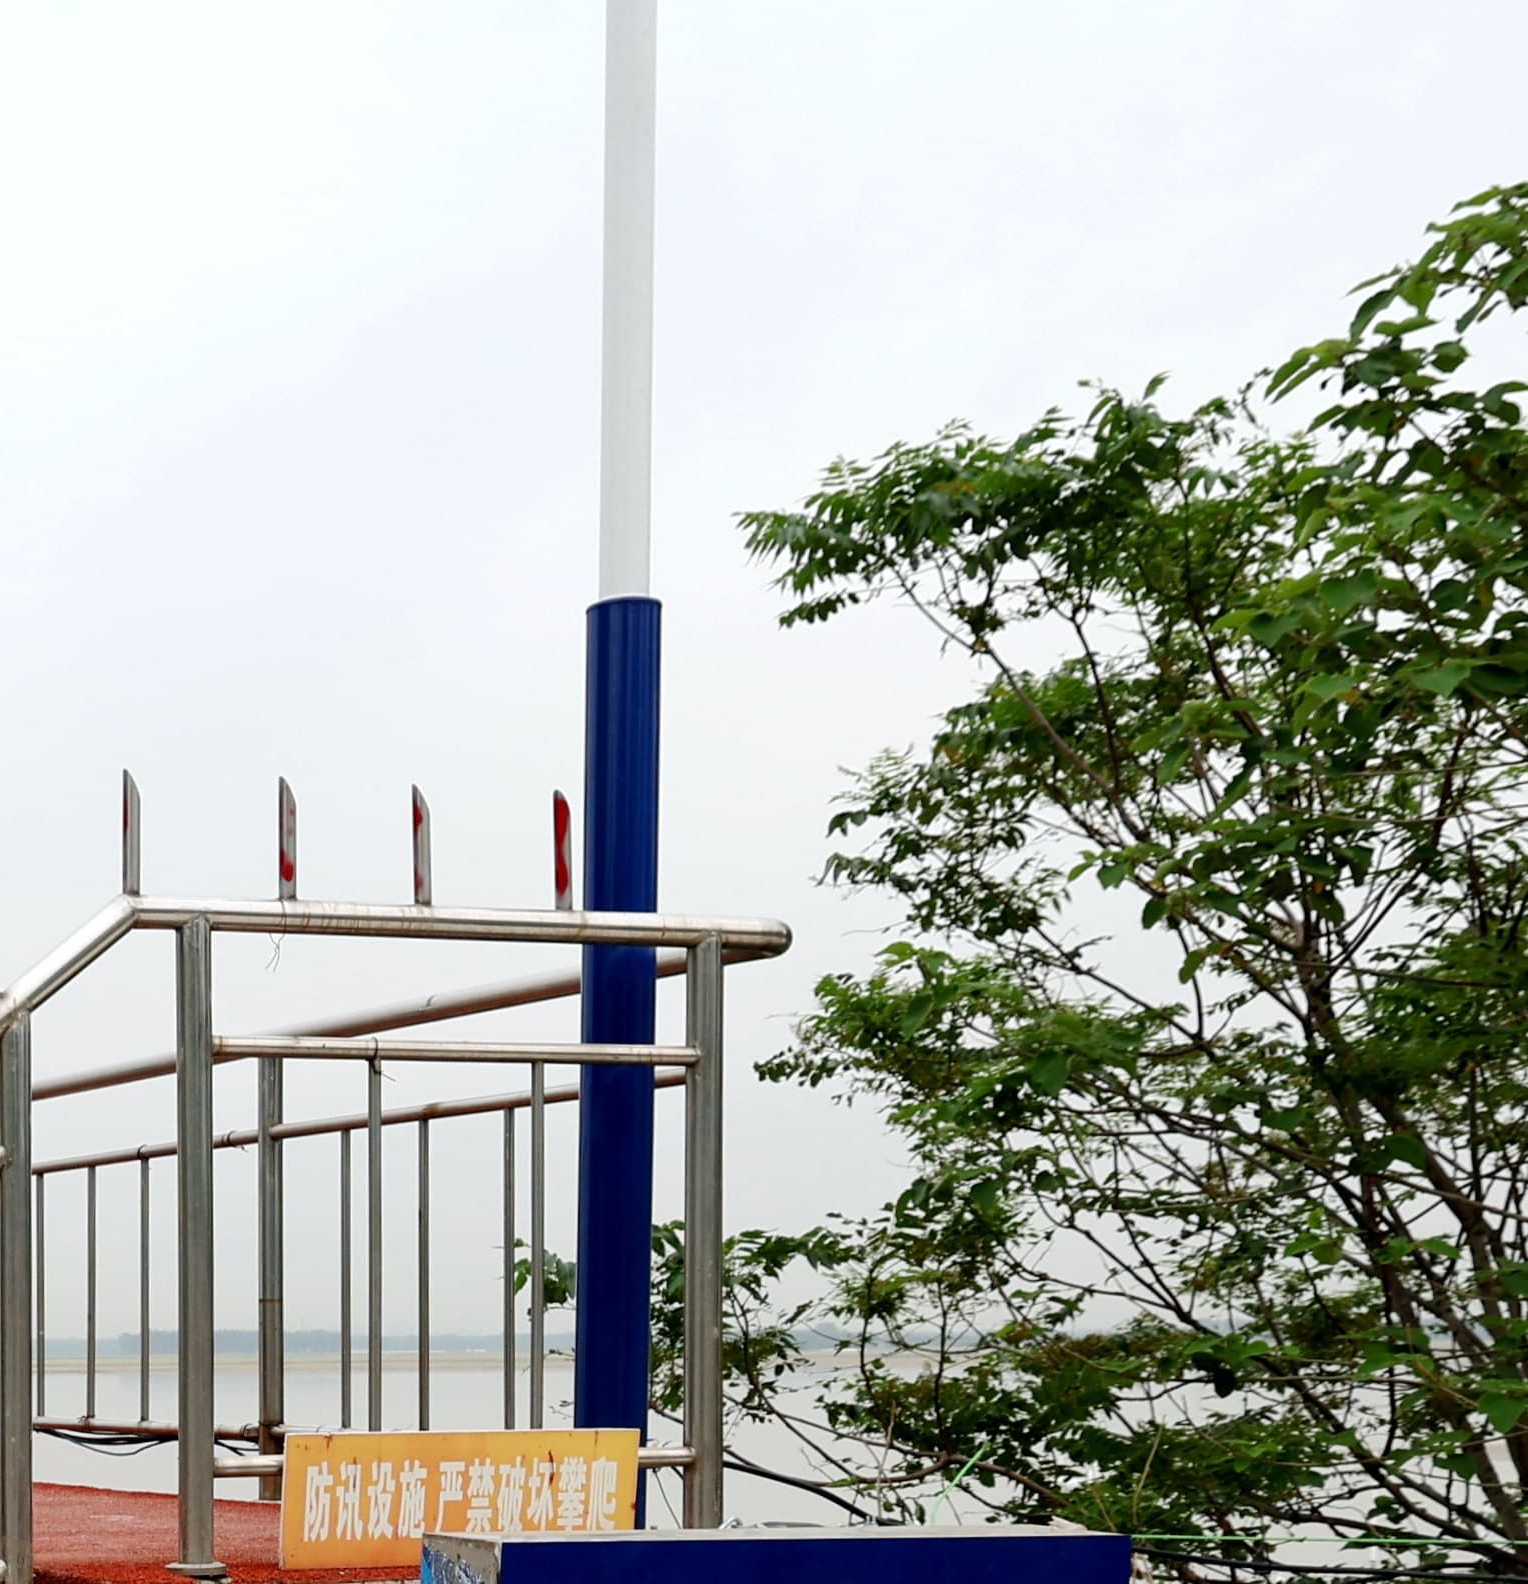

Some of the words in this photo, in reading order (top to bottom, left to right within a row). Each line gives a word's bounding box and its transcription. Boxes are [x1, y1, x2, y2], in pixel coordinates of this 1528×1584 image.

[433, 1455, 618, 1534] 严禁破坏攀爬
